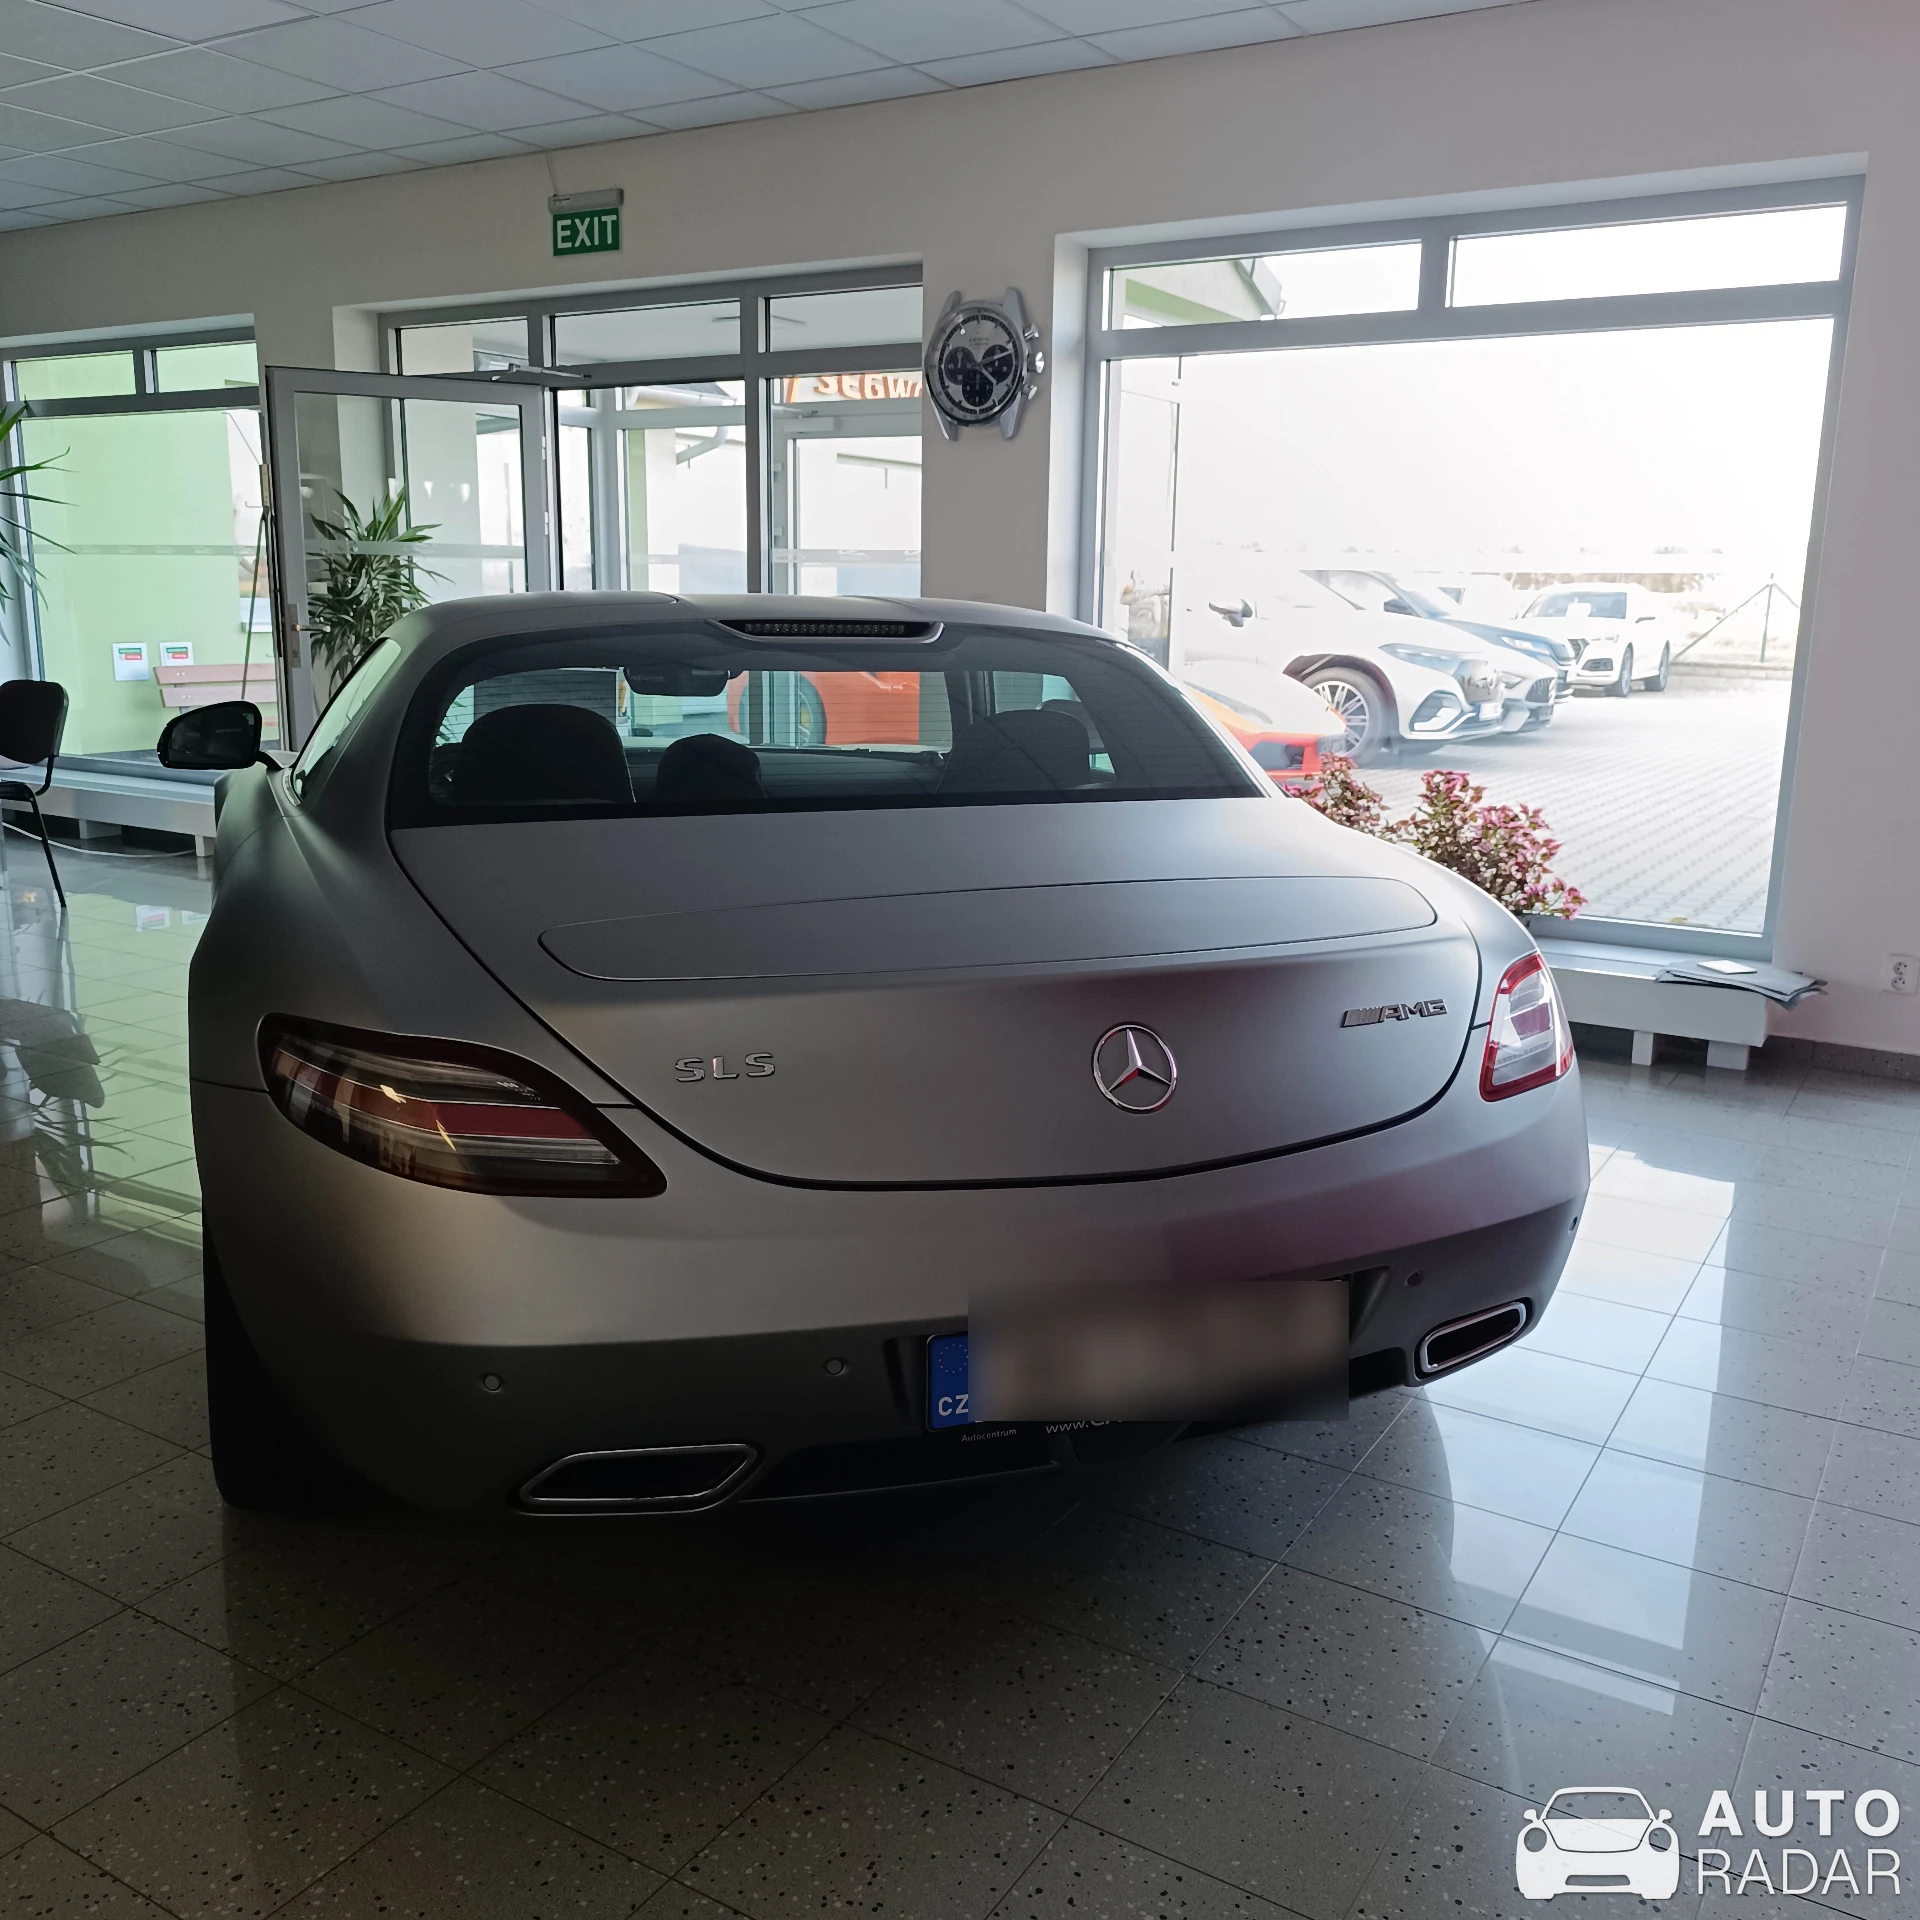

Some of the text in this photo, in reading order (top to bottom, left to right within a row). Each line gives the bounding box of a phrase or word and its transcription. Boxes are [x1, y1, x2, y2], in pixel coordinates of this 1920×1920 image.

[557, 215, 617, 248] EXIT
[1380, 999, 1447, 1022] AMG
[675, 1052, 775, 1082] SLS
[938, 1394, 968, 1416] CZ
[961, 1428, 1017, 1442] Autocentrum
